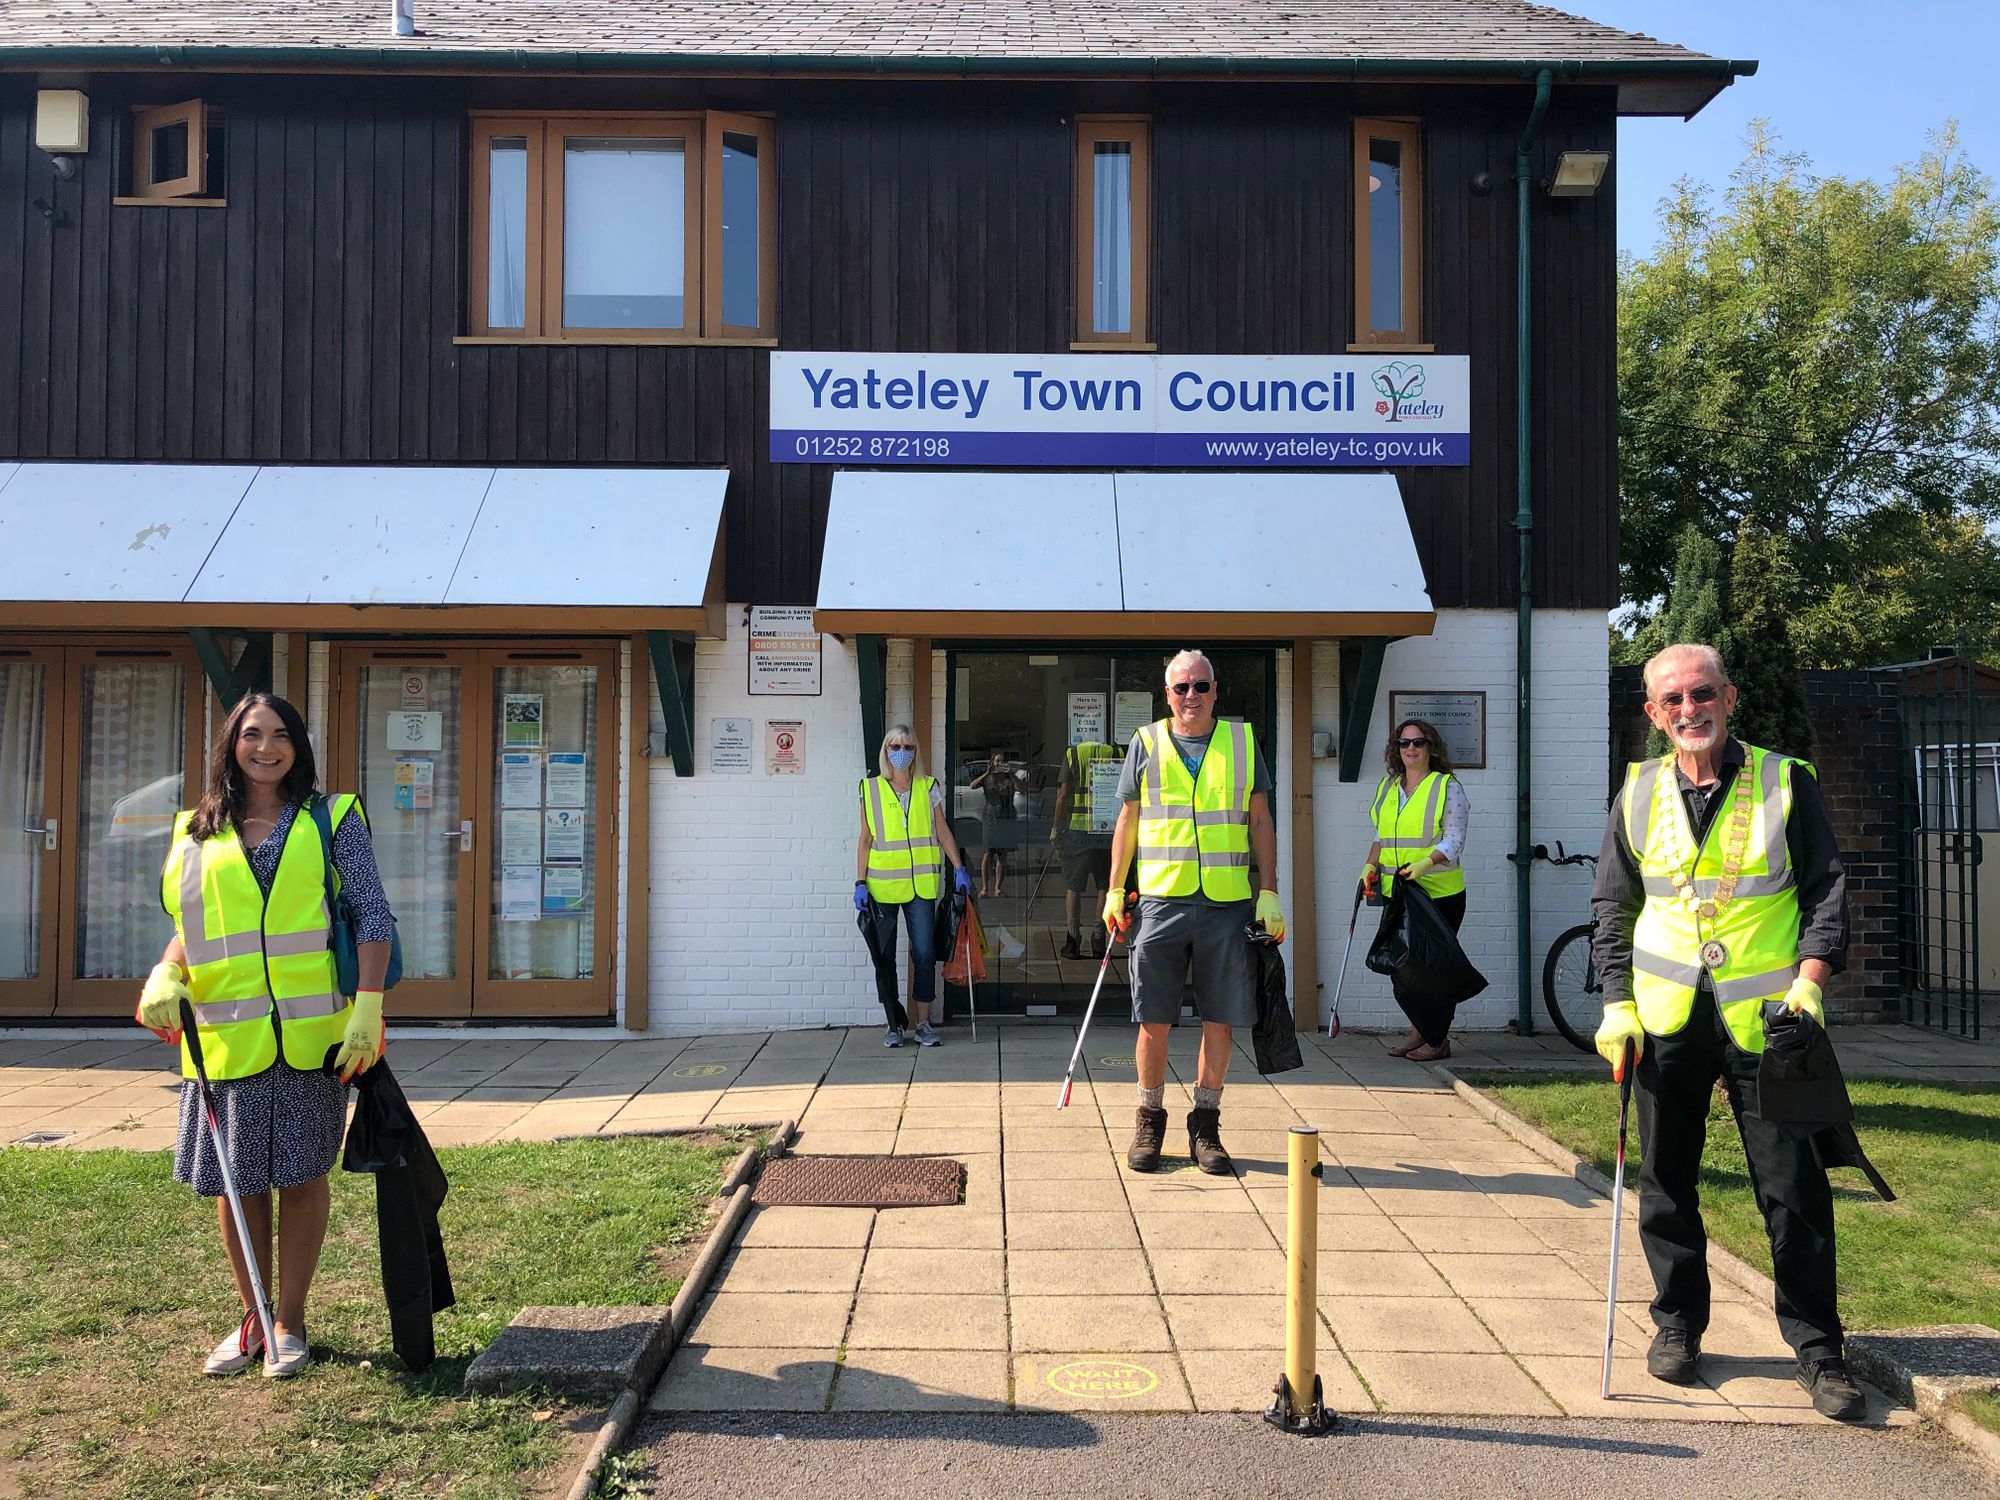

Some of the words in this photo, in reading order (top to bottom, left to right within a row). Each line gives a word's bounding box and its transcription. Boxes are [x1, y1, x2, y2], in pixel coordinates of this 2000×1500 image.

[801, 368, 990, 419] Yateley
[1013, 370, 1141, 411] Town
[1169, 371, 1355, 412] Council
[795, 436, 863, 456] 01252
[870, 437, 950, 457] 872198
[1205, 437, 1444, 461] www.yateley-tc.gov.uk
[754, 641, 778, 649] 0800
[780, 641, 797, 649] 555
[800, 641, 817, 649] 111
[1066, 1369, 1138, 1378] WAIT
[1068, 1380, 1140, 1390] HERE
